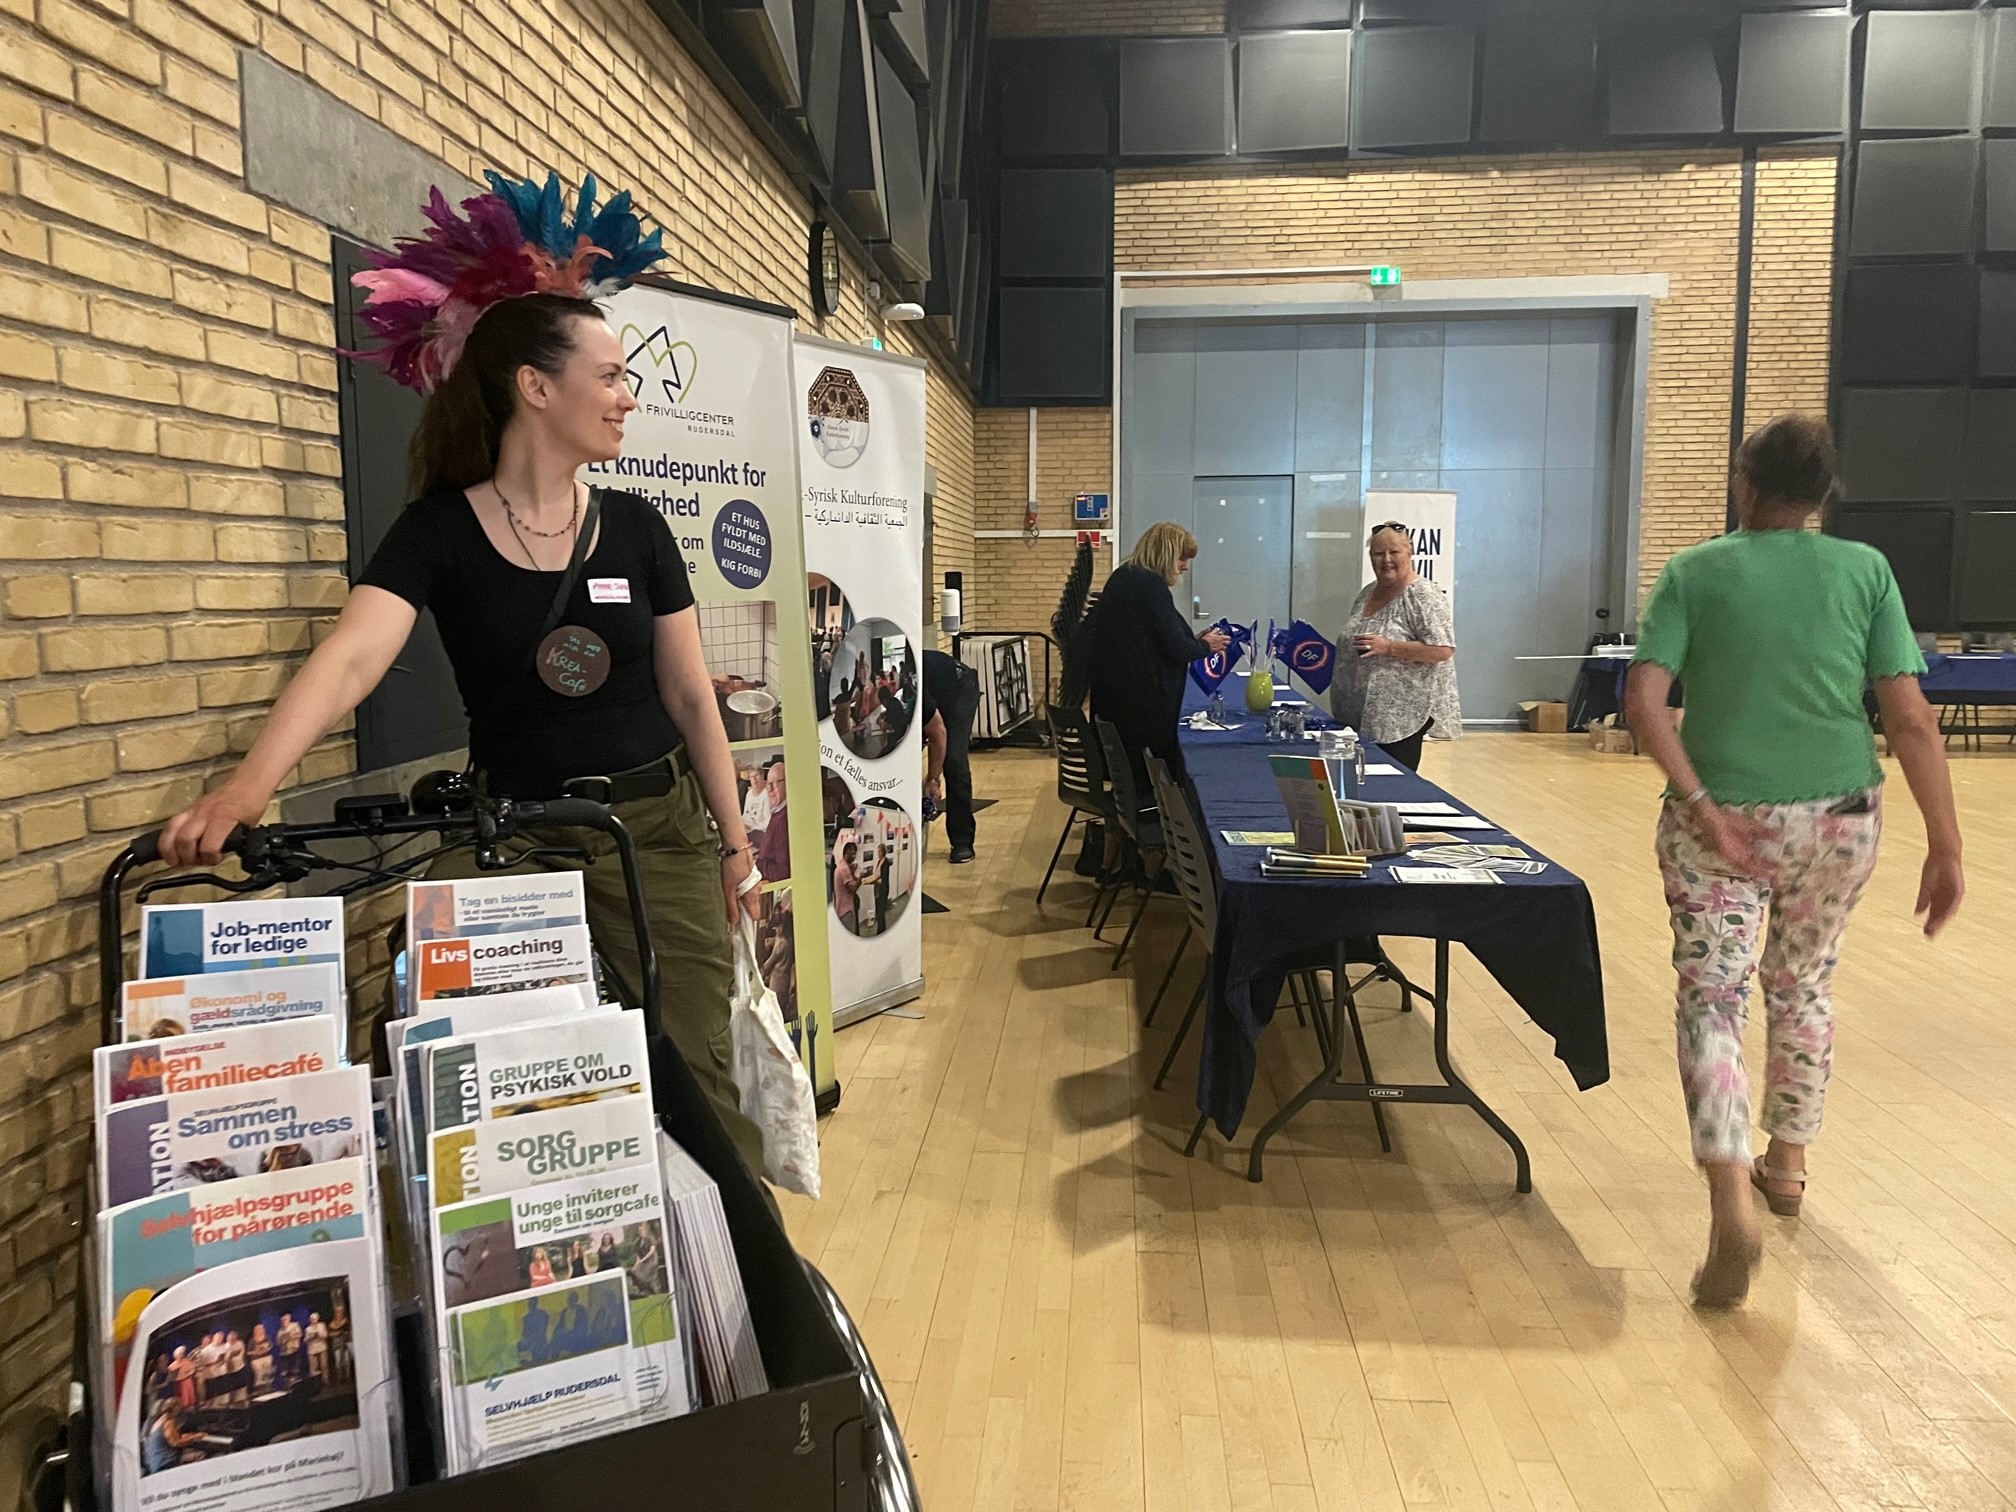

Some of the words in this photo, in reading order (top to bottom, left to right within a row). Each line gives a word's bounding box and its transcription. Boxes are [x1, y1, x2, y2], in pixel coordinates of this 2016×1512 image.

[646, 404, 734, 425] FRIVILLIGCENTER
[687, 425, 735, 438] RUDERSDAL
[615, 453, 739, 487] knudepunkt
[742, 461, 767, 487] for
[841, 489, 907, 513] Kulturforening
[731, 512, 742, 523] ET
[743, 516, 760, 530] HUS
[681, 537, 704, 550] om
[721, 522, 747, 539] FYLDT
[748, 532, 767, 546] MED
[721, 557, 736, 571] KIG
[737, 563, 762, 579] FORBI
[1209, 653, 1220, 669] DF
[1301, 649, 1320, 661] DF
[835, 753, 844, 766] et
[844, 758, 868, 787] fælles
[459, 897, 480, 907] Tag
[484, 897, 498, 905] en
[549, 890, 573, 900] med
[211, 918, 332, 938] Job-mentor
[211, 939, 243, 955] for
[245, 936, 308, 953] ledige
[190, 992, 262, 1008] Økonomi
[266, 992, 287, 1003] og
[166, 1052, 324, 1094] familiecafé
[489, 1057, 568, 1084] GRUPPE
[574, 1053, 604, 1069] OM
[491, 1072, 577, 1100] PSYKISK
[581, 1064, 632, 1085] VOLD
[178, 1104, 297, 1138] Sammen
[228, 1129, 269, 1149] om
[275, 1116, 353, 1142] stress
[497, 1130, 576, 1162] SORG
[527, 1137, 641, 1175] GRUPPE
[517, 1199, 563, 1219] Unge
[566, 1183, 639, 1207] inviterer
[192, 1224, 227, 1246] for
[231, 1202, 354, 1240] pårørende
[519, 1216, 563, 1234] unge
[565, 1208, 582, 1224] til
